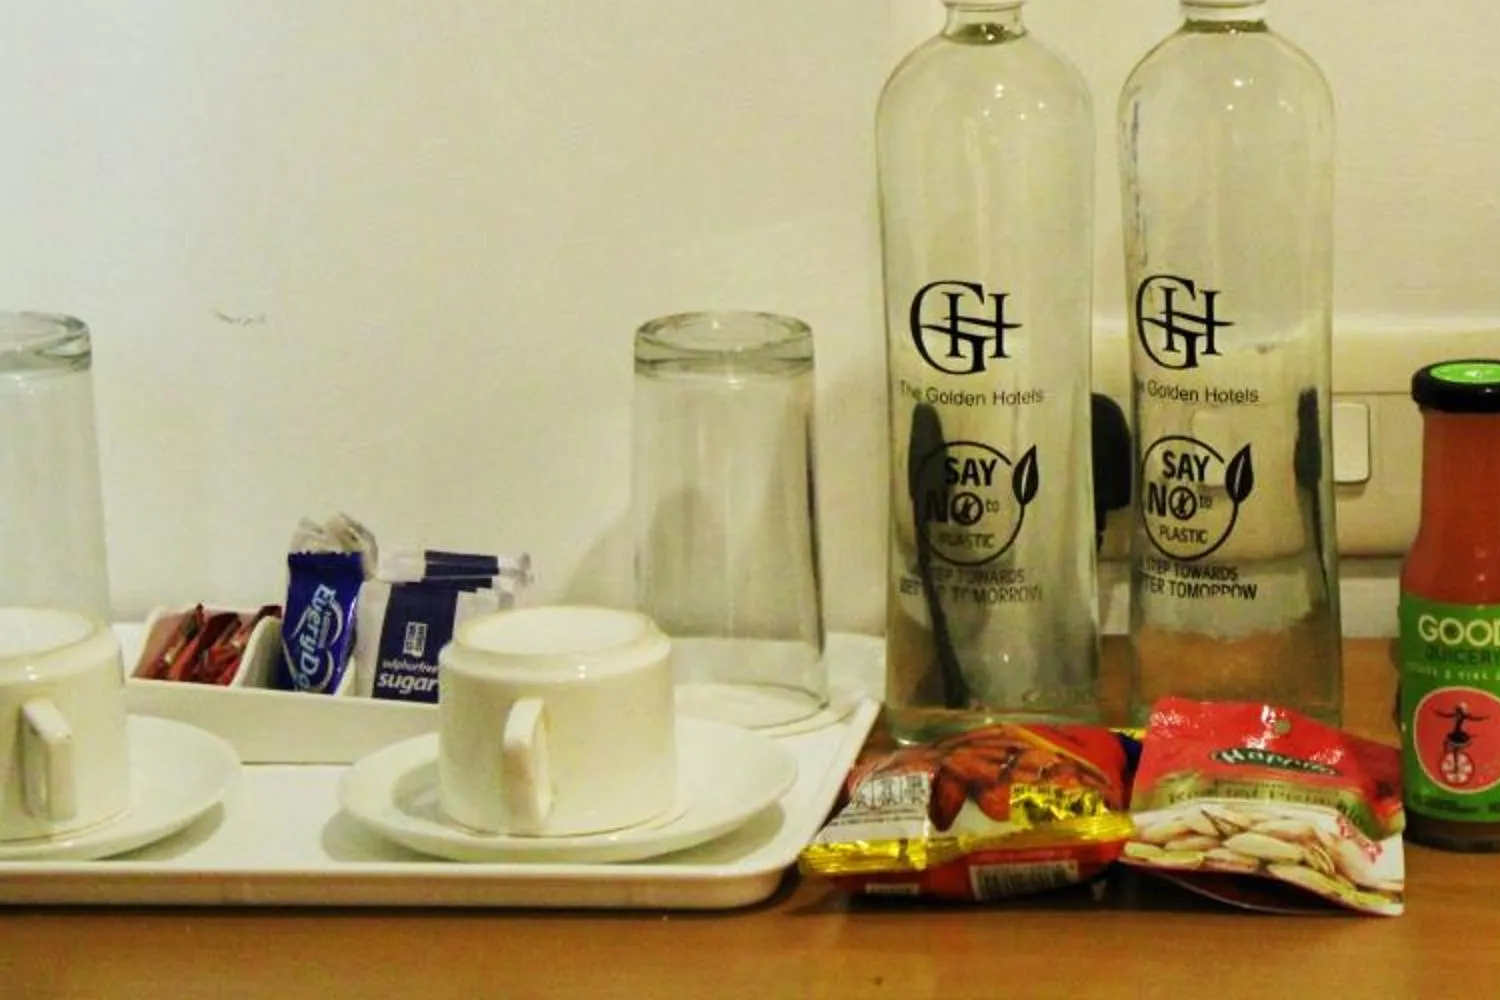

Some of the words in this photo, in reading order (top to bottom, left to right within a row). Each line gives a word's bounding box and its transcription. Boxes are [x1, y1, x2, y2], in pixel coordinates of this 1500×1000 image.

[925, 386, 987, 407] Golden
[992, 388, 1045, 407] Hotels
[1147, 379, 1199, 402] Golden
[1205, 385, 1259, 404] Hotels
[944, 457, 998, 487] SAY
[1162, 450, 1211, 483] SAY
[1160, 526, 1208, 544] PLASTIC
[1173, 561, 1239, 582] TOWARDS
[1168, 580, 1258, 600] TOMORROW
[376, 671, 439, 695] sugar
